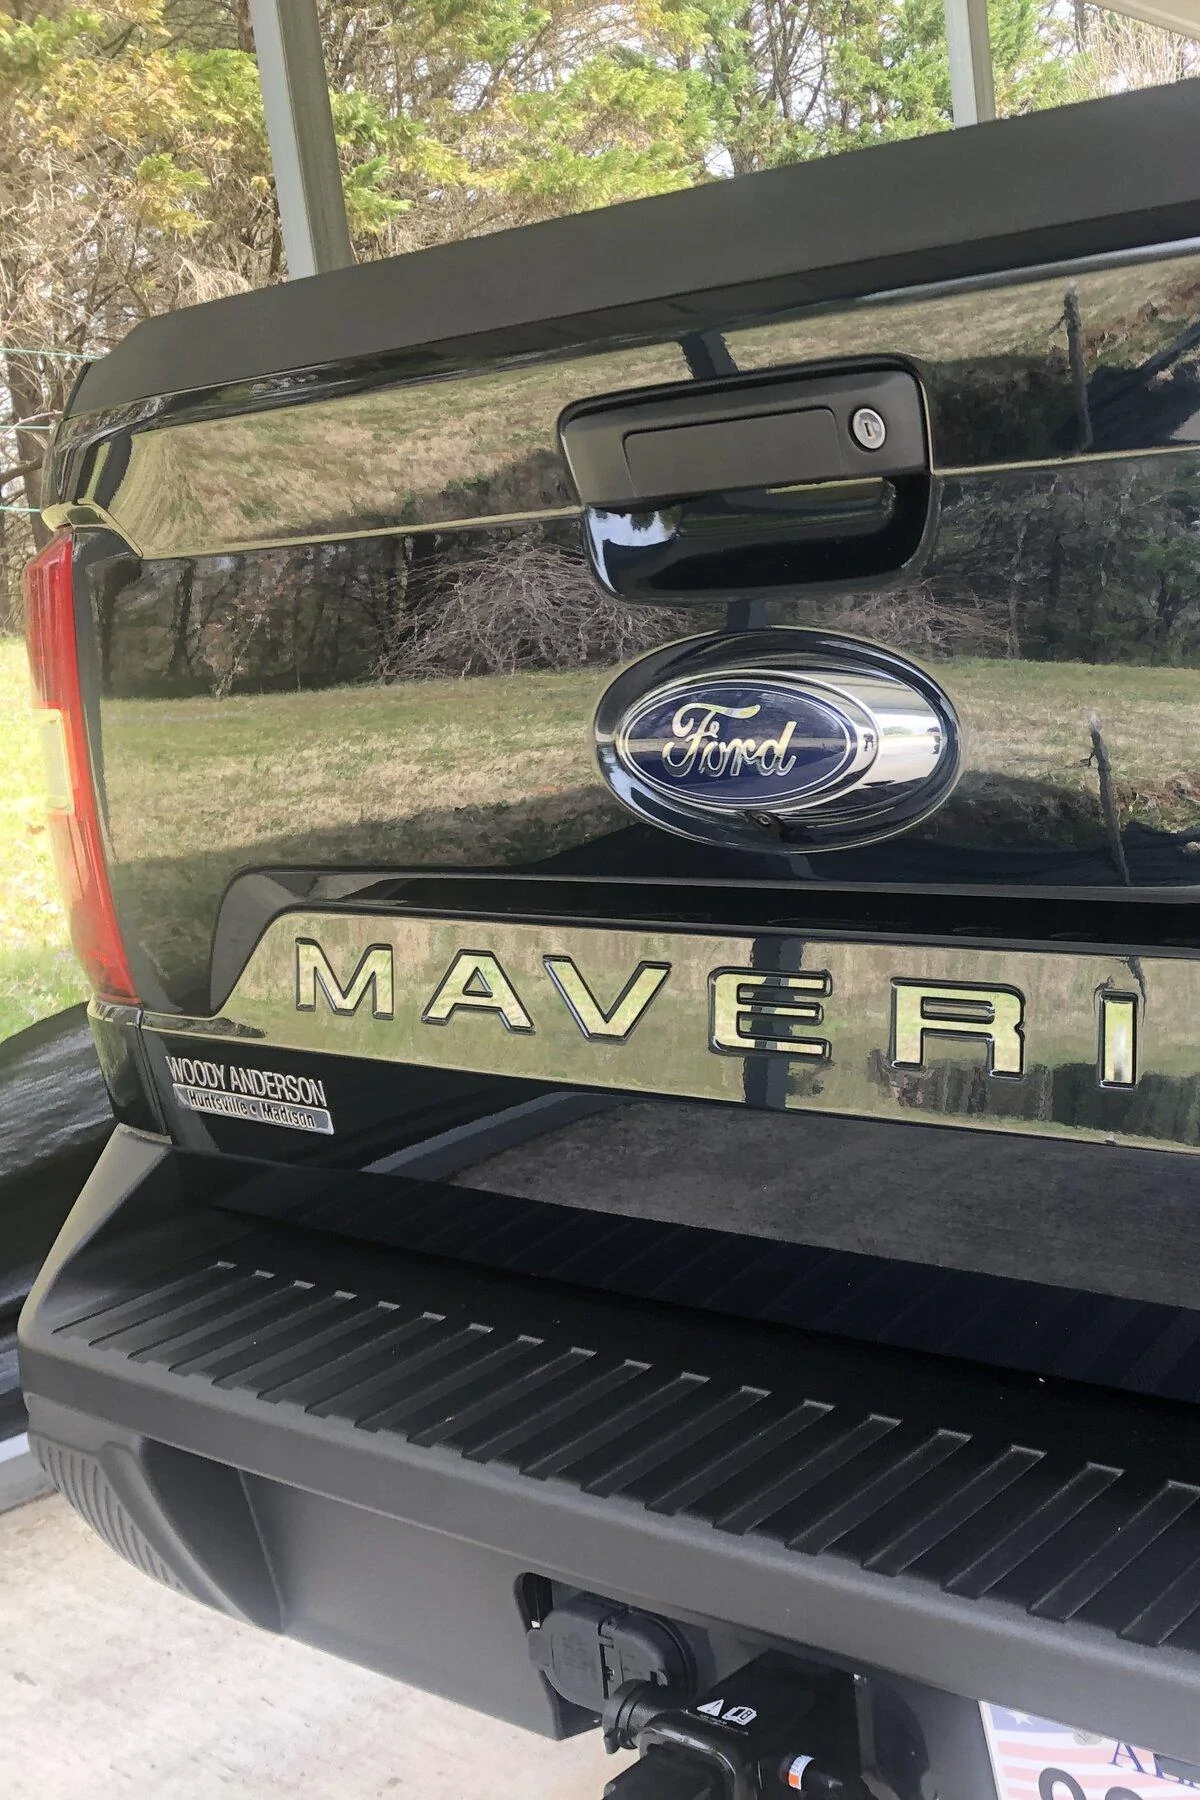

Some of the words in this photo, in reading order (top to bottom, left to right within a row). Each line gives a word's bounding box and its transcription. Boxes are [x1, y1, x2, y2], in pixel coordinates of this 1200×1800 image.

[662, 703, 797, 777] Ford
[165, 1056, 226, 1090] WOODY
[229, 1066, 328, 1107] ANDERSON
[187, 1089, 248, 1117] Huntsville
[259, 1101, 316, 1129] Madison
